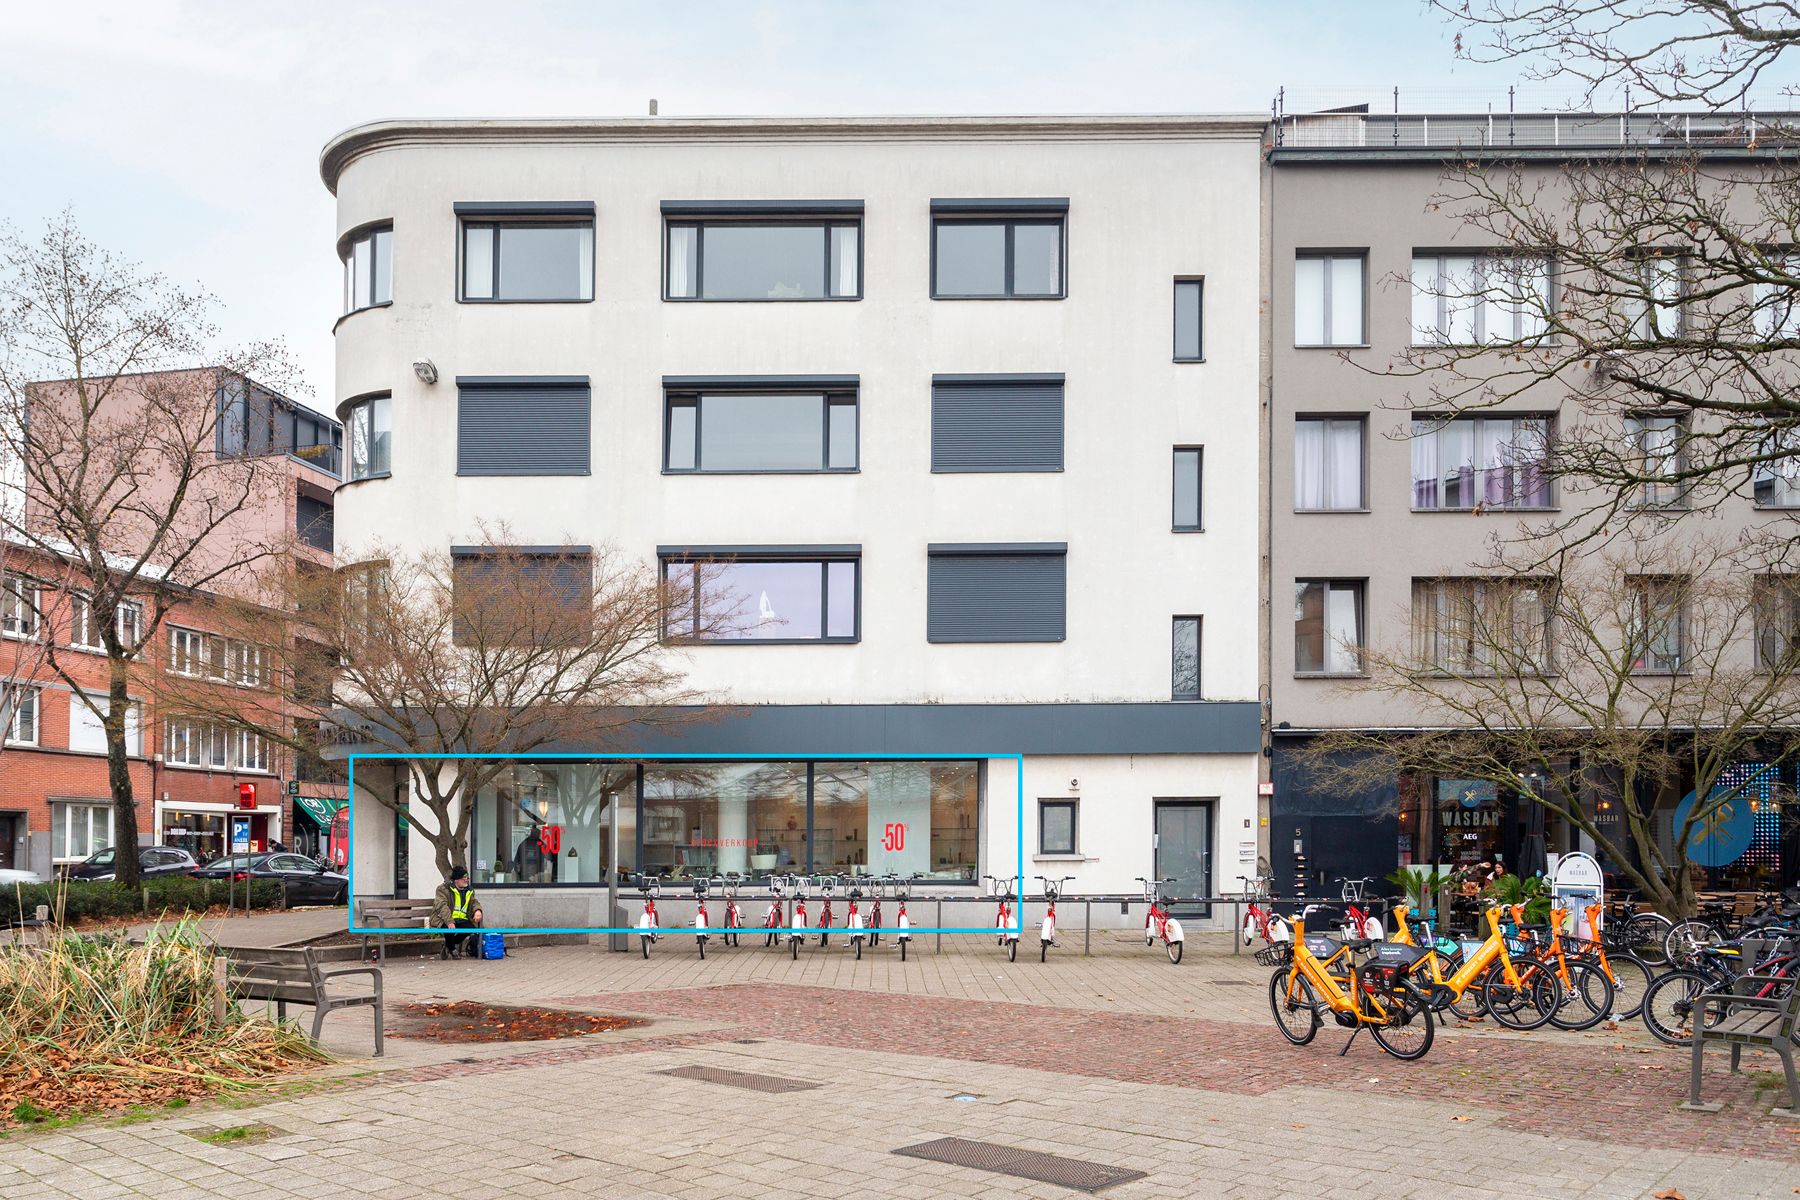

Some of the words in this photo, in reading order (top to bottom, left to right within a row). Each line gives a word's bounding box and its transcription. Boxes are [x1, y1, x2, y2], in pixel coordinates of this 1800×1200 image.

[1442, 811, 1500, 827] WASBAR
[234, 824, 242, 837] P
[1295, 828, 1302, 837] 5
